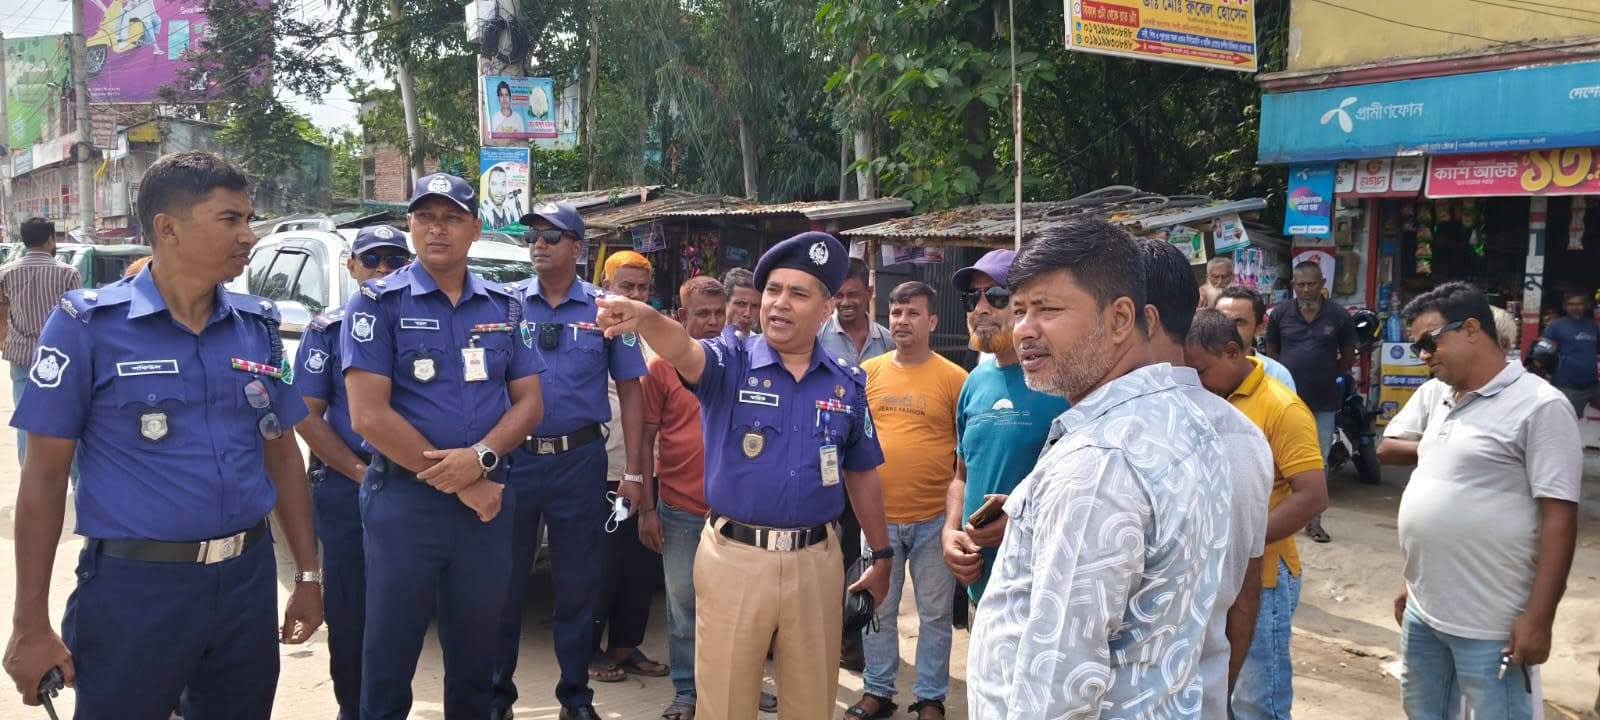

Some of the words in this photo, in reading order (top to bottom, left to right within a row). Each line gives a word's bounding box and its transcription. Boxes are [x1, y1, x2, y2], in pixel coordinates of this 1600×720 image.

[1217, 5, 1248, 24] হোসেন
[1355, 101, 1425, 121] গ্রামীণফোন
[1434, 166, 1469, 180] ক্যাশ
[1473, 161, 1518, 179] আউট
